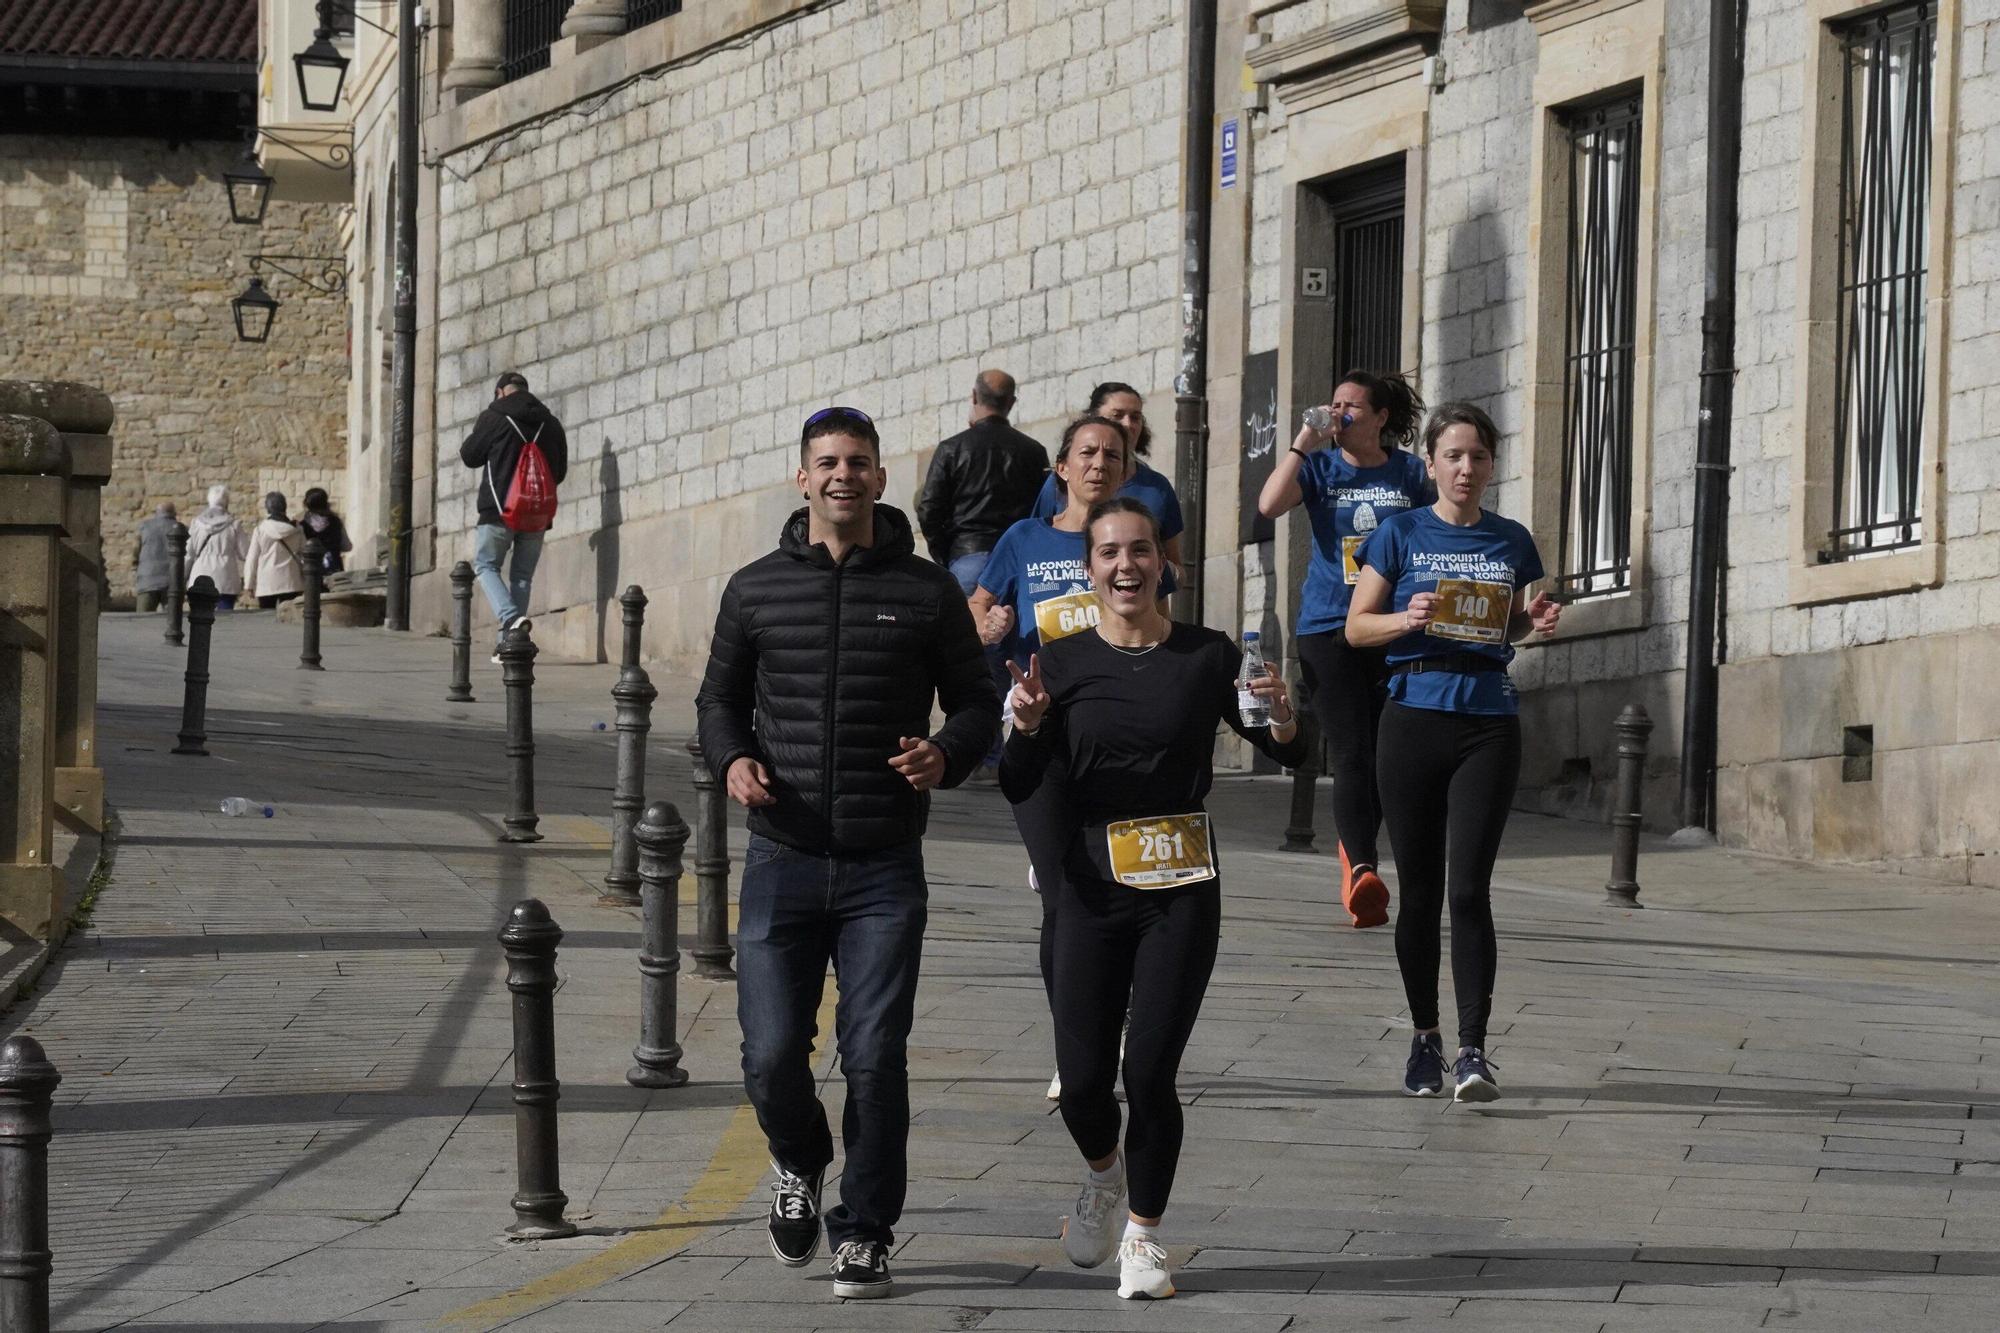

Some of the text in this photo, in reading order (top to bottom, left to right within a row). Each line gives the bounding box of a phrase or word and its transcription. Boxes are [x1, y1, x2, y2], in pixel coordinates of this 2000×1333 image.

[1338, 486, 1386, 494] CONQUISTA
[1338, 490, 1403, 501] ALMENDRA
[1373, 500, 1411, 508] KONKISTA
[1412, 552, 1487, 562] LA CONQUISTA
[1027, 562, 1039, 571] LA
[1430, 561, 1509, 572] ALMENDRA
[1454, 594, 1489, 619] 140
[1059, 605, 1101, 632] 640
[1138, 832, 1184, 862] 261
